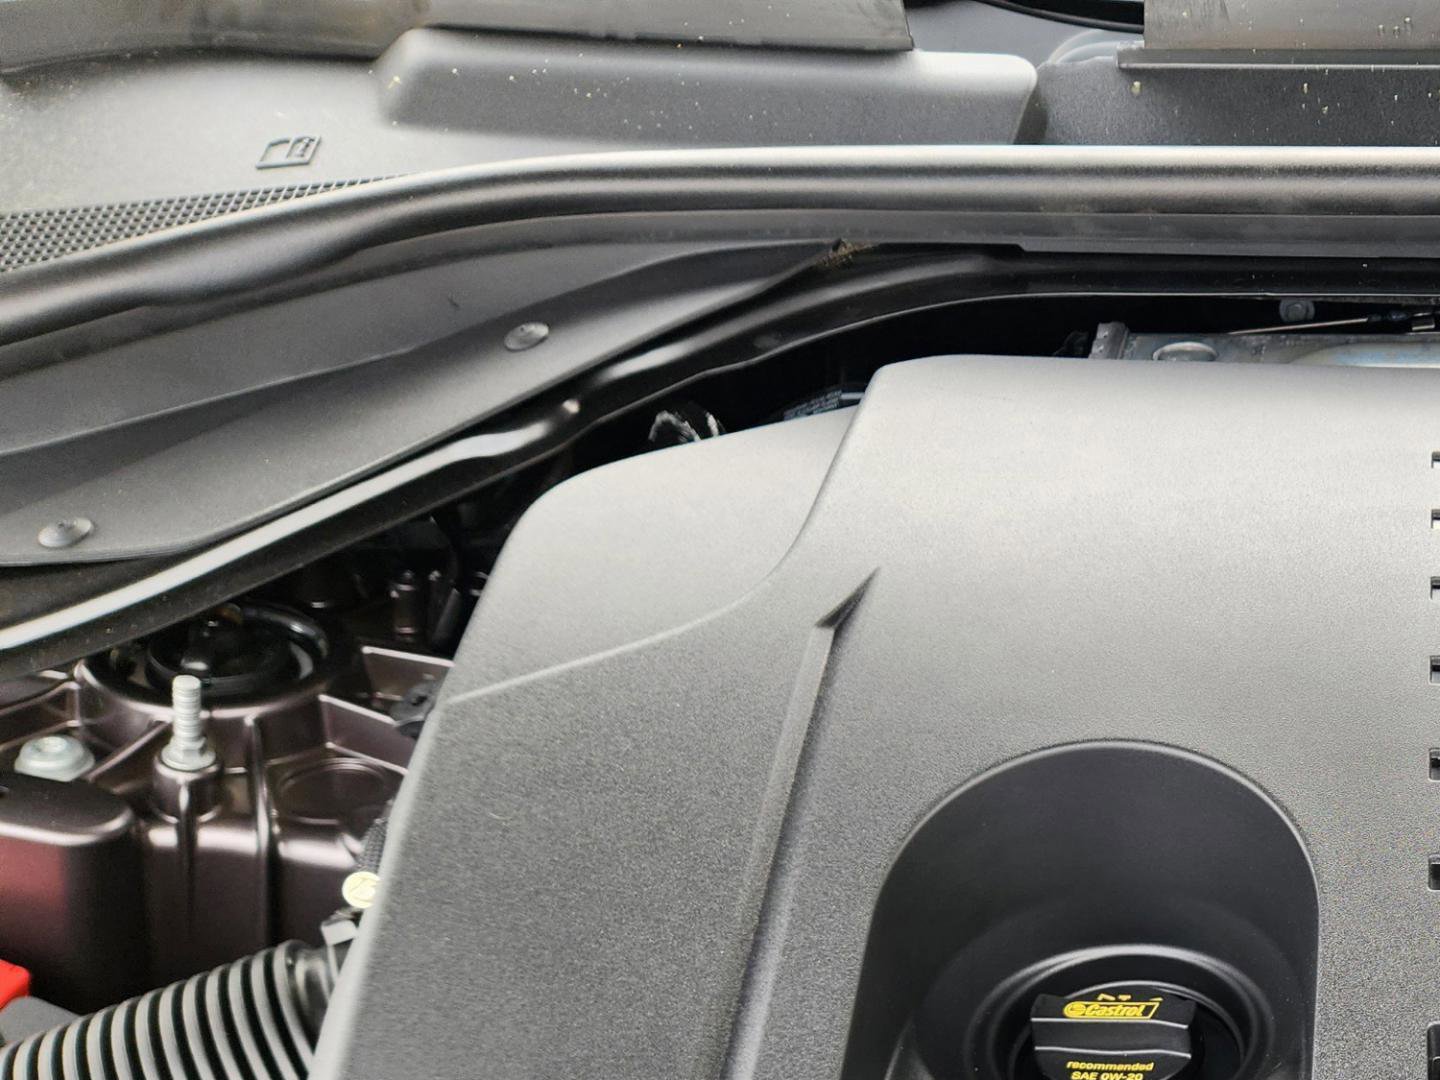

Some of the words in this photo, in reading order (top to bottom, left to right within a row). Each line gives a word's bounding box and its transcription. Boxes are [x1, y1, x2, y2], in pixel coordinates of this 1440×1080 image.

[1085, 1004, 1145, 1017] Castrol
[1066, 1061, 1154, 1071] recommended
[1071, 1072, 1098, 1080] SAE
